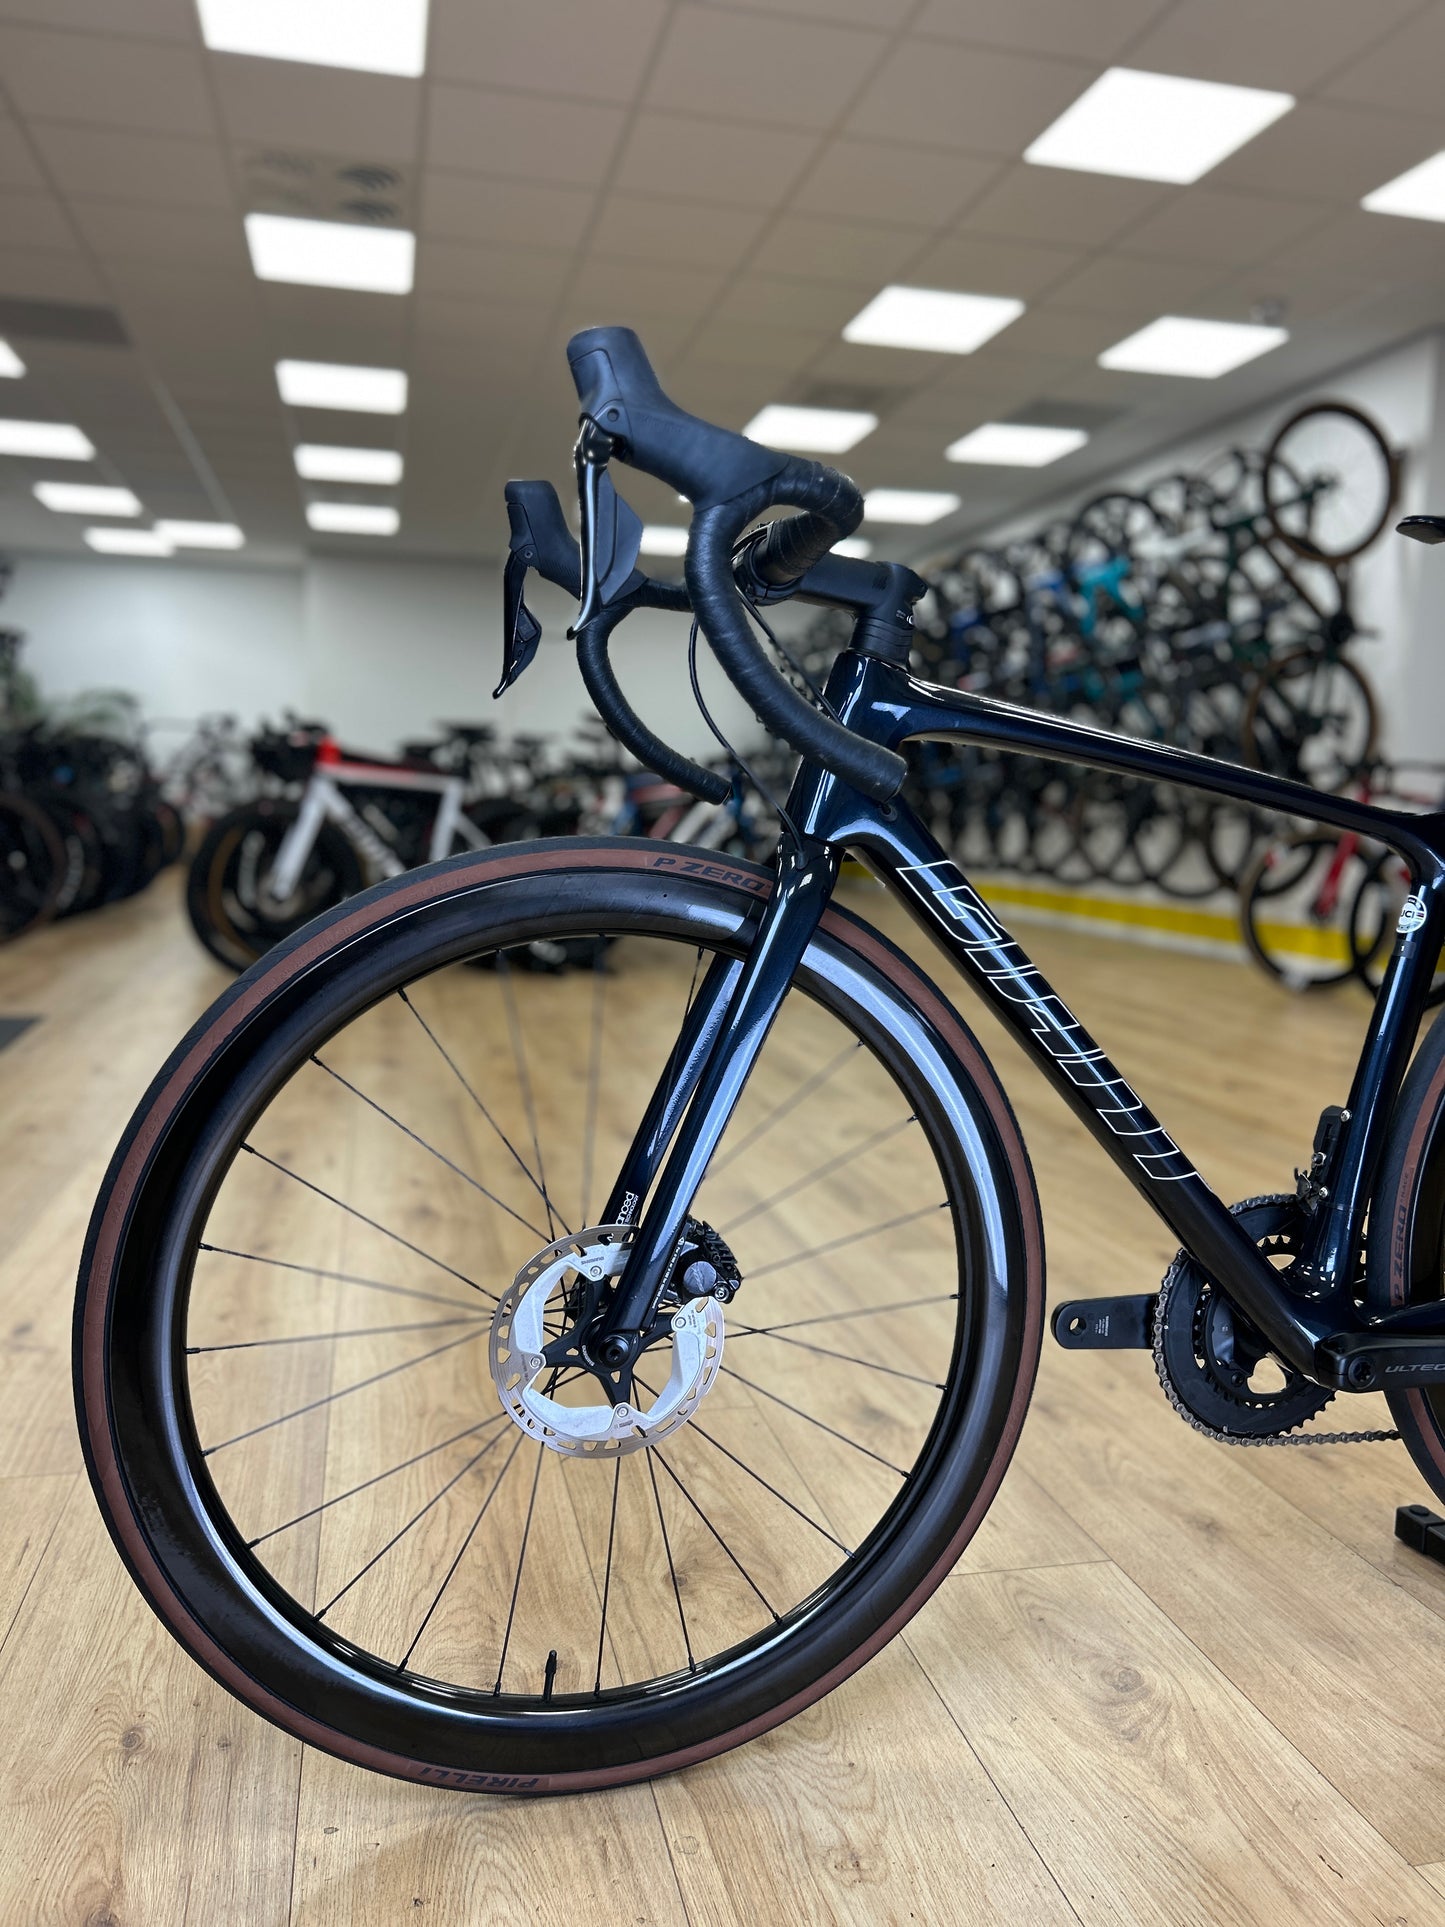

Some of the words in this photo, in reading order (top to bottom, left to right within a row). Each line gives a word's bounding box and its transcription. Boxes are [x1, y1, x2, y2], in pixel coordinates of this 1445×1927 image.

[653, 857, 676, 868] P
[679, 861, 766, 891] ZERO
[895, 860, 1213, 1193] GIANT
[417, 1766, 540, 1789] PIRELLI
